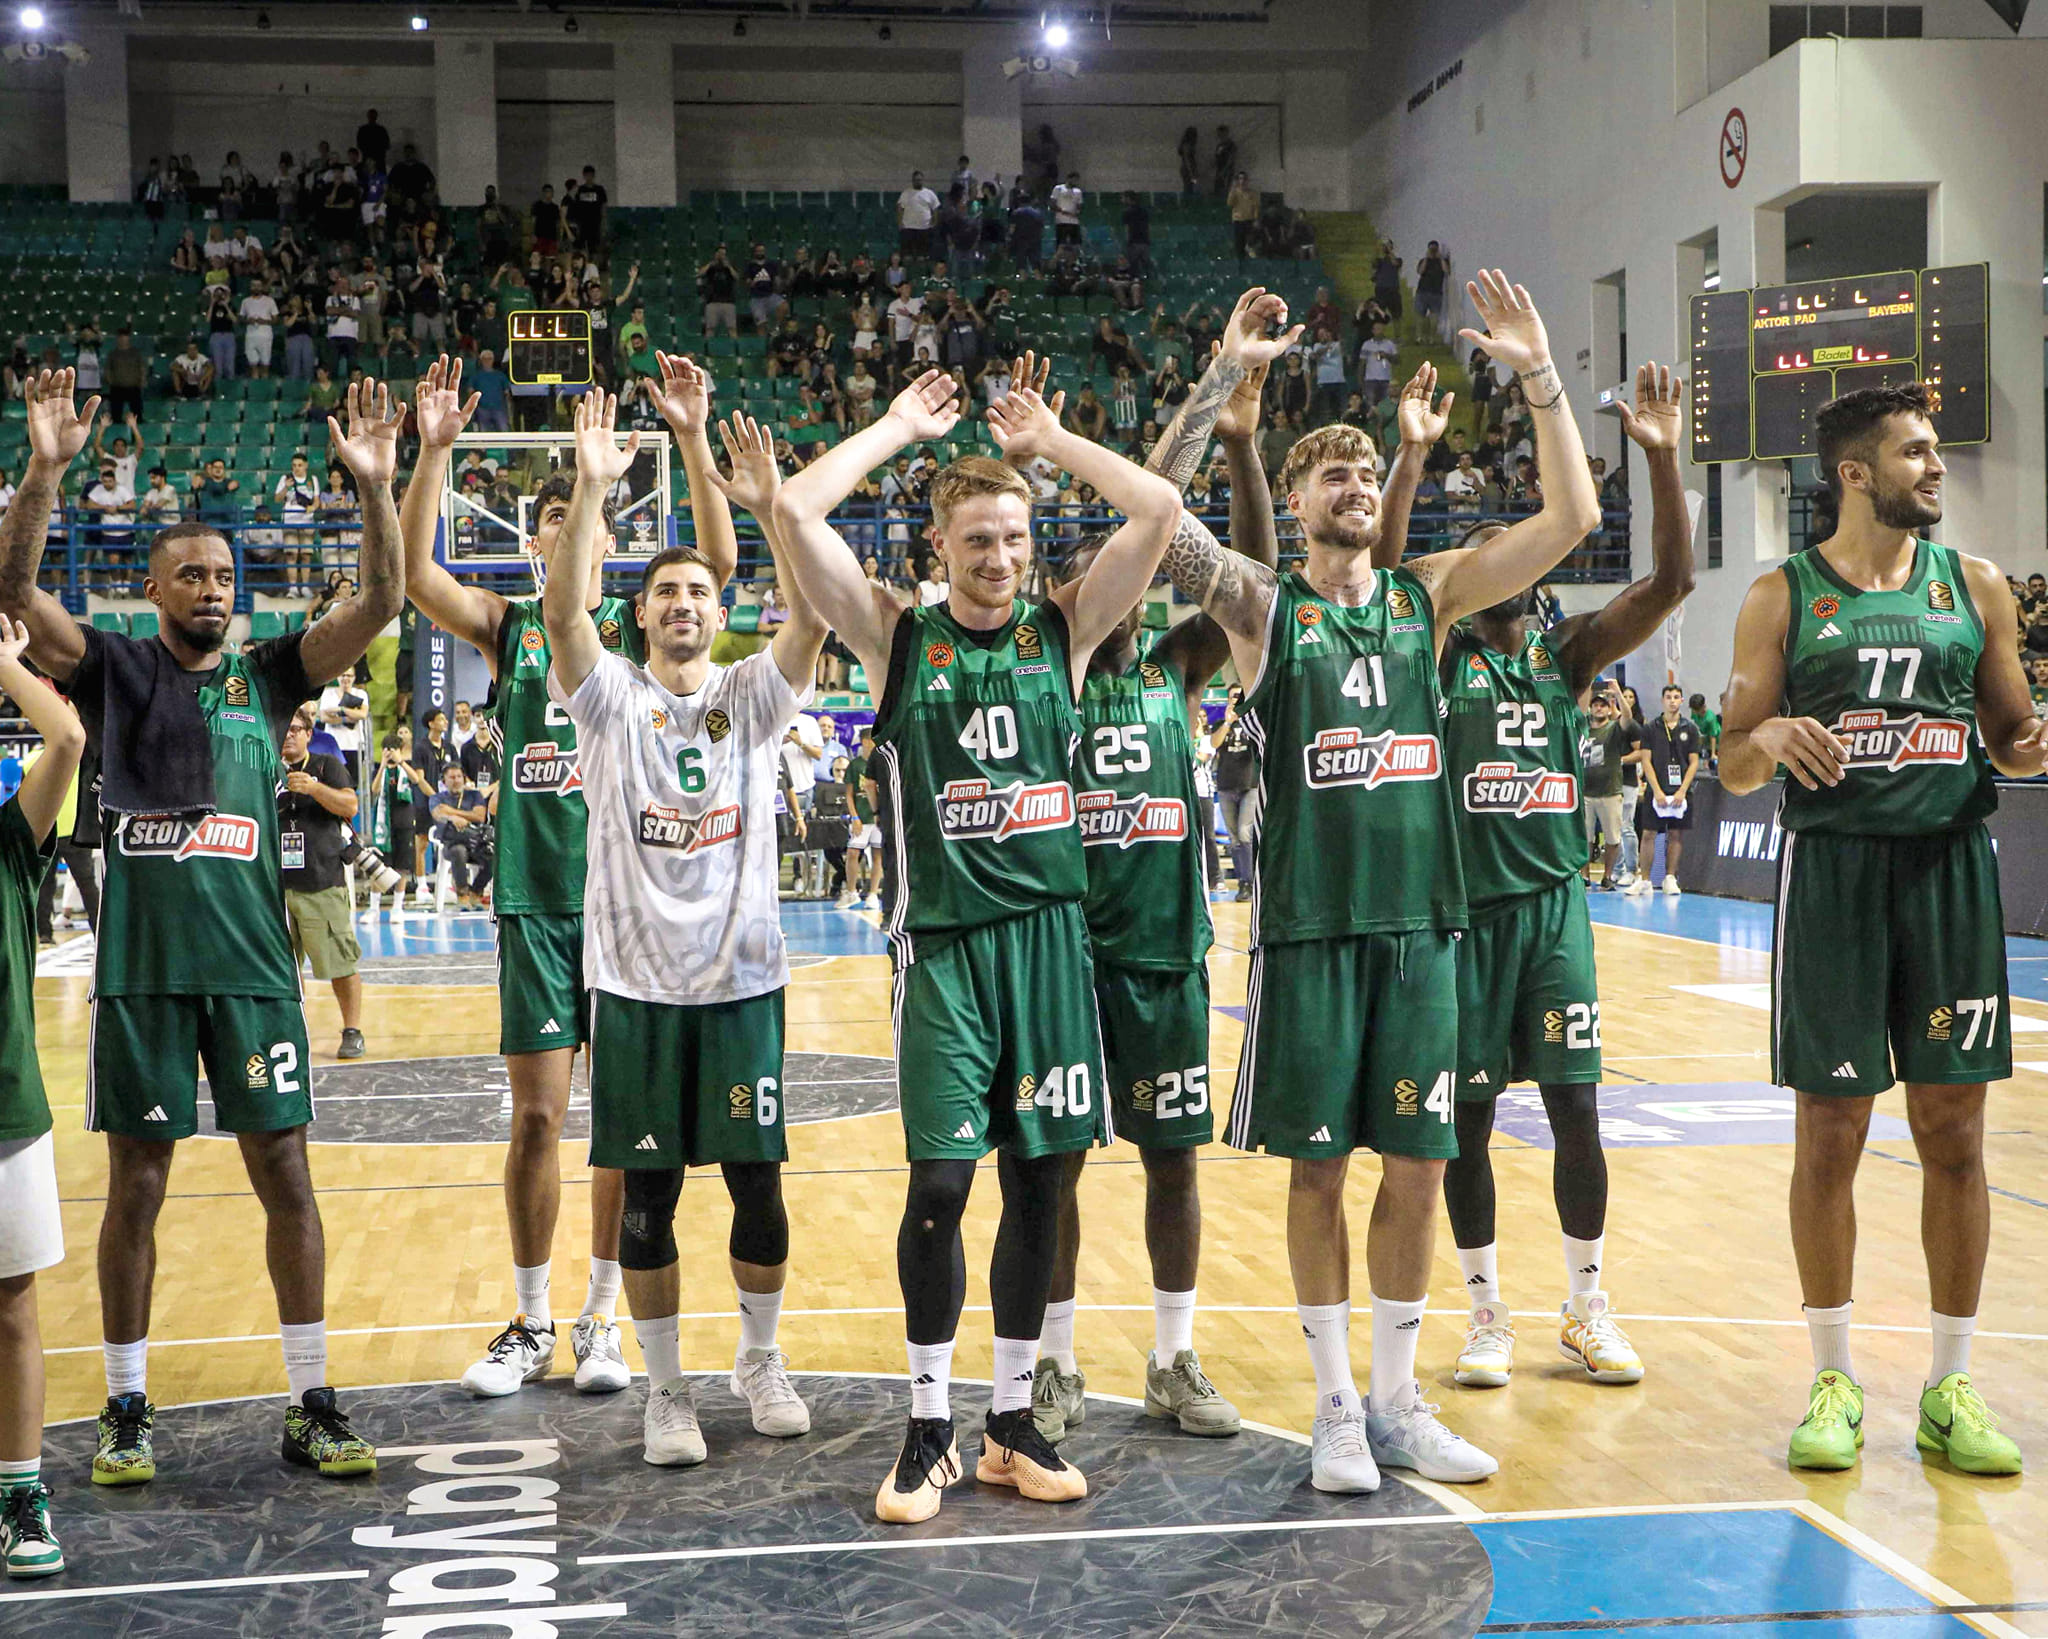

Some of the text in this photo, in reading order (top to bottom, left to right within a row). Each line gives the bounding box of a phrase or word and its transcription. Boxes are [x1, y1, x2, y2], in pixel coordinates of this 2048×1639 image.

[1754, 302, 1915, 330] AKTOR PAO BAYERN
[1816, 350, 1850, 360] Bodet
[1341, 655, 1387, 707] 41
[1858, 647, 1922, 699] 77
[958, 705, 1018, 760] 40
[1322, 733, 1354, 748] pame
[1497, 702, 1548, 746] 22
[1846, 714, 1879, 728] pame
[528, 746, 553, 759] pame
[676, 747, 706, 793] 6
[1094, 724, 1150, 775] 25
[1481, 766, 1511, 778] pame
[951, 783, 983, 798] pame
[1080, 794, 1110, 809] pame
[1956, 995, 1999, 1051] 77
[270, 1042, 300, 1093] 2
[1034, 1063, 1091, 1118] 40
[757, 1077, 777, 1126] 6
[1156, 1065, 1208, 1119] 25
